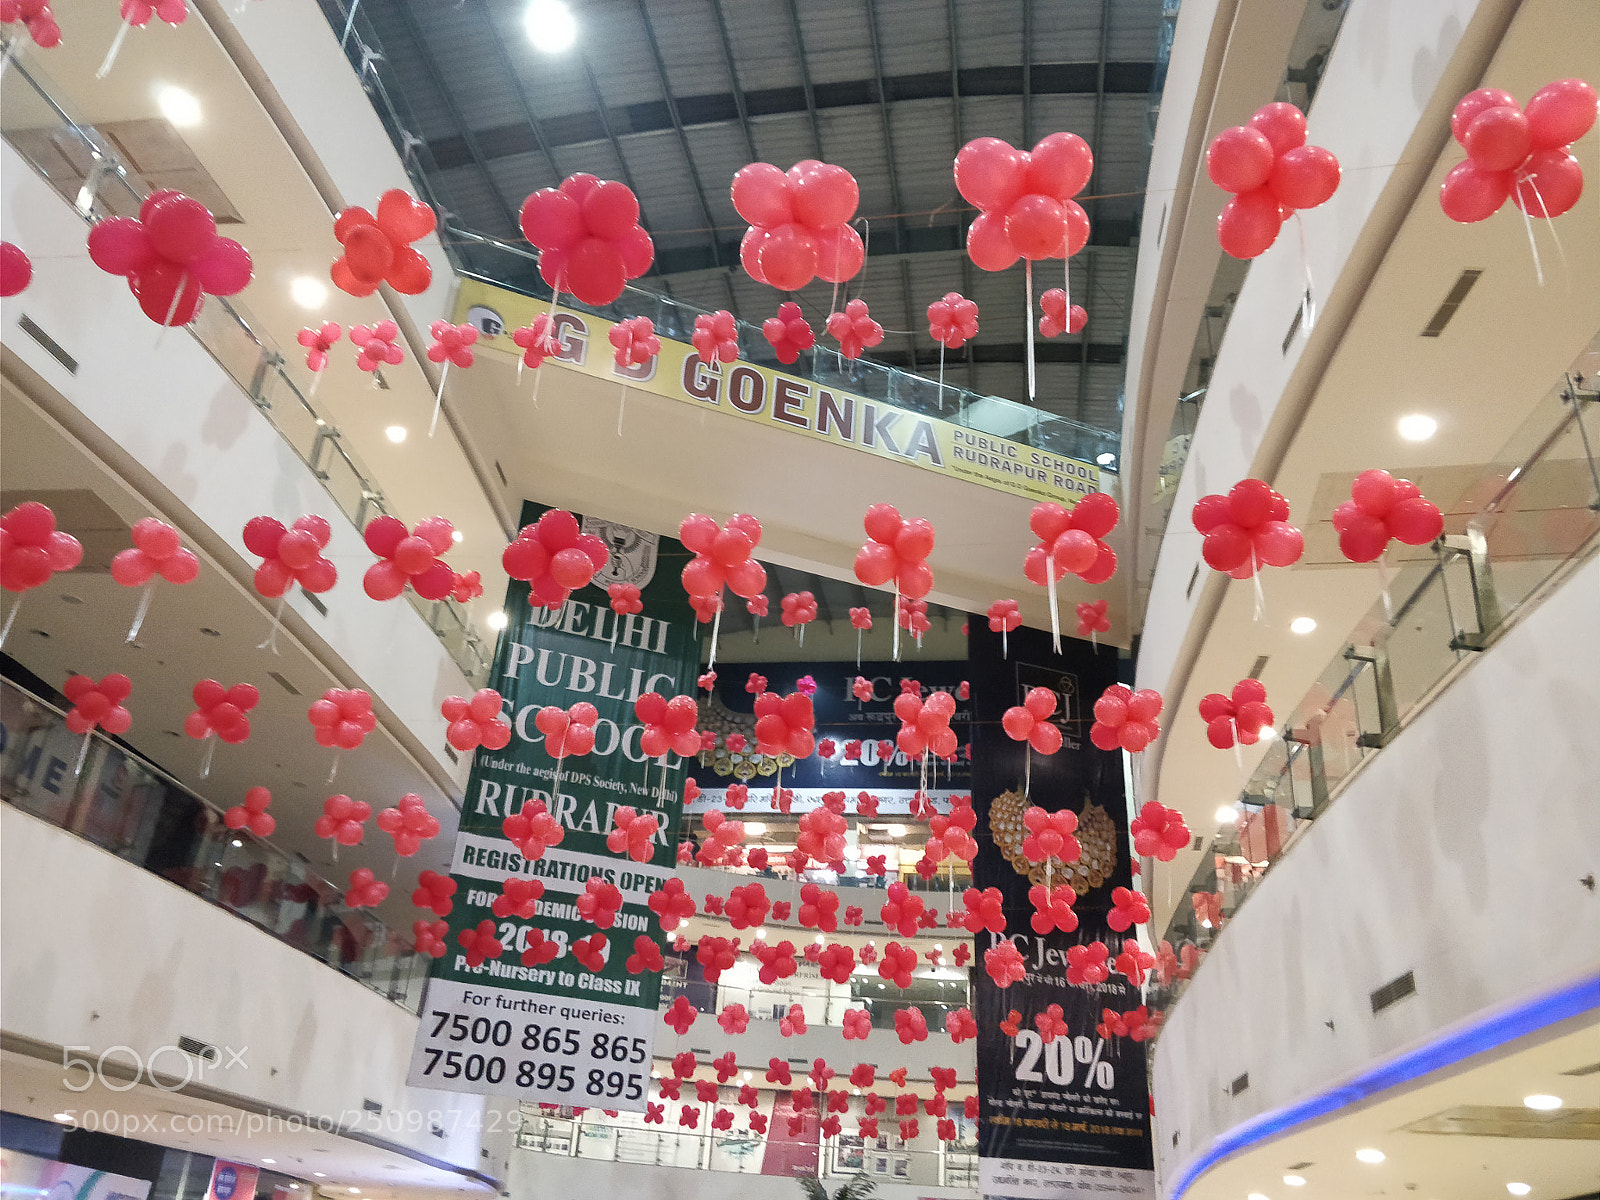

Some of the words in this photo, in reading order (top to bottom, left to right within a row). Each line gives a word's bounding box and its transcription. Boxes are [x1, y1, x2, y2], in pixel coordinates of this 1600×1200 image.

[681, 352, 945, 468] GOENKA
[952, 445, 1048, 483] RUDRAPUR
[953, 429, 1018, 458] PUBLIC
[1030, 452, 1099, 483] SCHOOL
[515, 761, 531, 774] the
[533, 765, 558, 781] aegis
[559, 767, 570, 781] of
[571, 770, 591, 786] DPS
[592, 774, 628, 795] Society,
[630, 782, 648, 796] New
[463, 845, 615, 886] REGISTRATIONS
[463, 990, 491, 1007] For
[496, 995, 557, 1015] further
[560, 1004, 626, 1025] queries:
[558, 972, 575, 988] to
[577, 974, 622, 995] Class
[624, 979, 642, 998] IX
[430, 1010, 512, 1047] 7500
[521, 1023, 580, 1056] 865
[590, 1032, 647, 1064] 865
[1015, 1029, 1115, 1091] 20%
[423, 1047, 506, 1083] 7500
[515, 1060, 576, 1093] 895
[586, 1069, 643, 1100] 895
